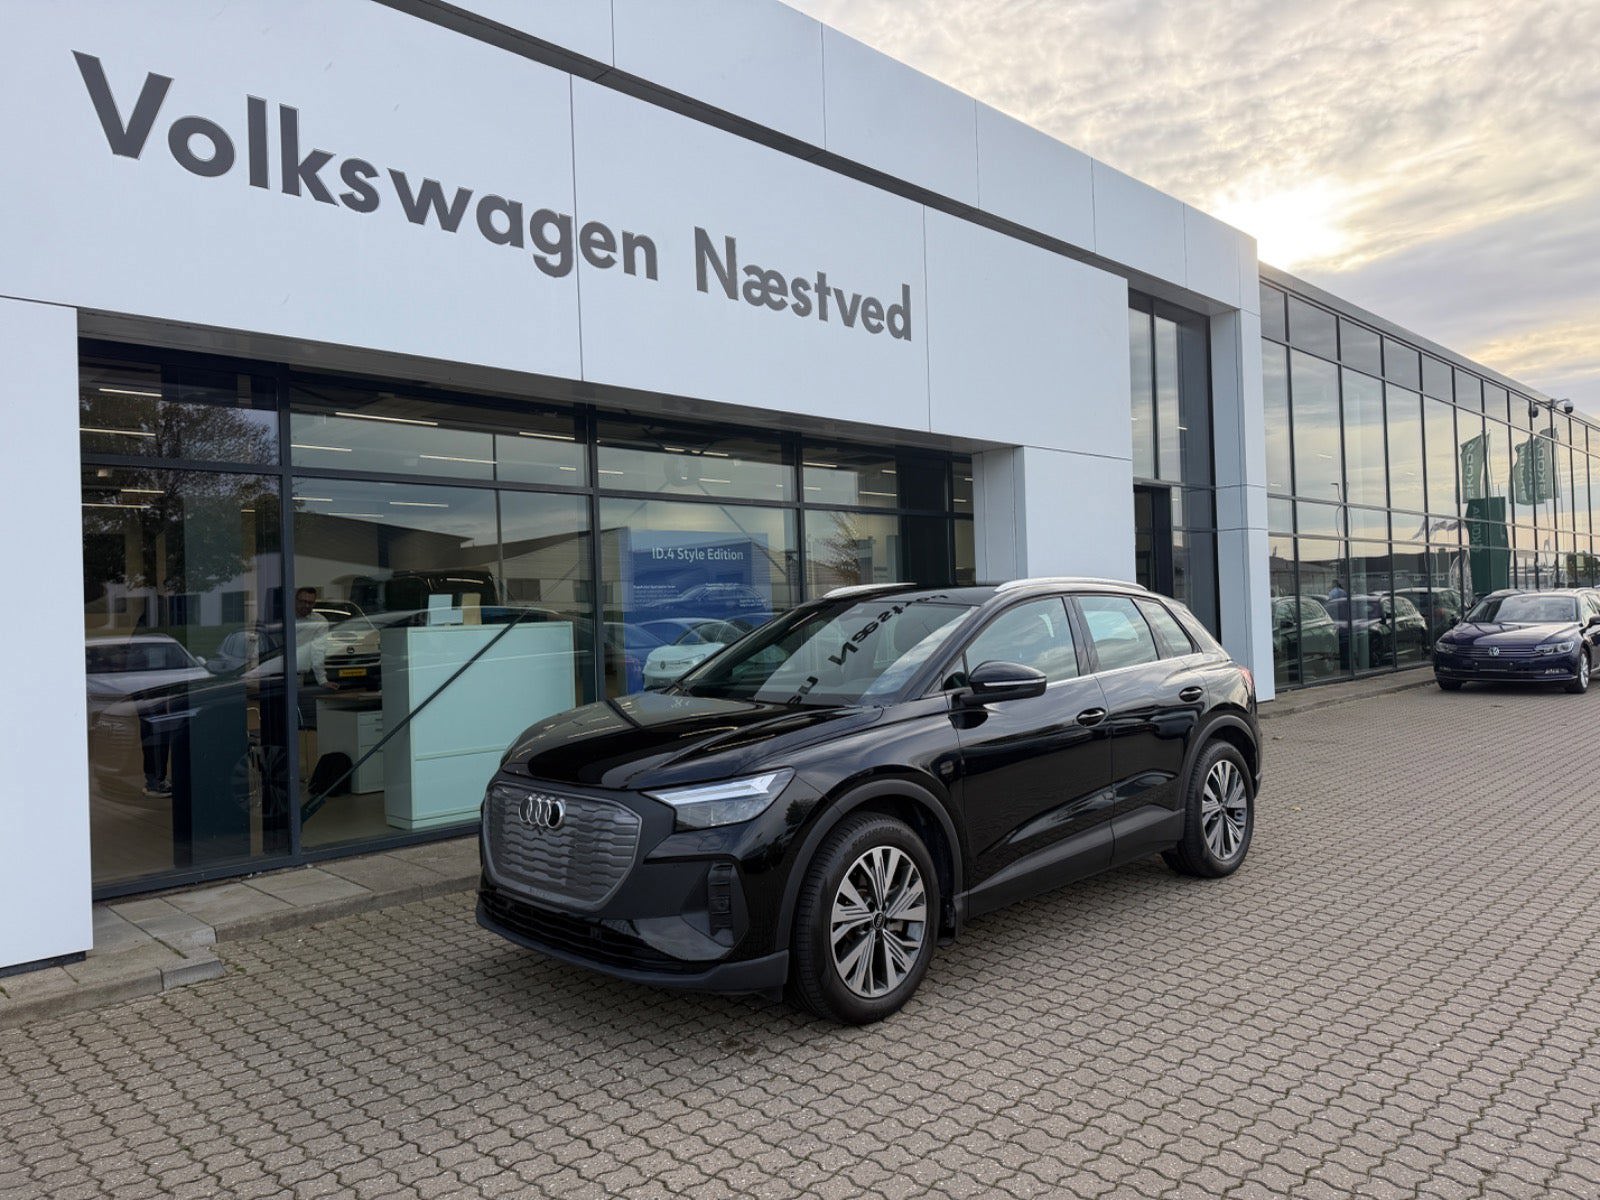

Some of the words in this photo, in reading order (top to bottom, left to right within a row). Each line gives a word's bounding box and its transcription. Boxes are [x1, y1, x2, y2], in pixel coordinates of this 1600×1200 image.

[71, 50, 659, 281] Volkswagen
[694, 226, 912, 342] Næstved
[652, 548, 675, 560] ID.4
[677, 548, 705, 563] Style
[707, 549, 744, 561] Edition
